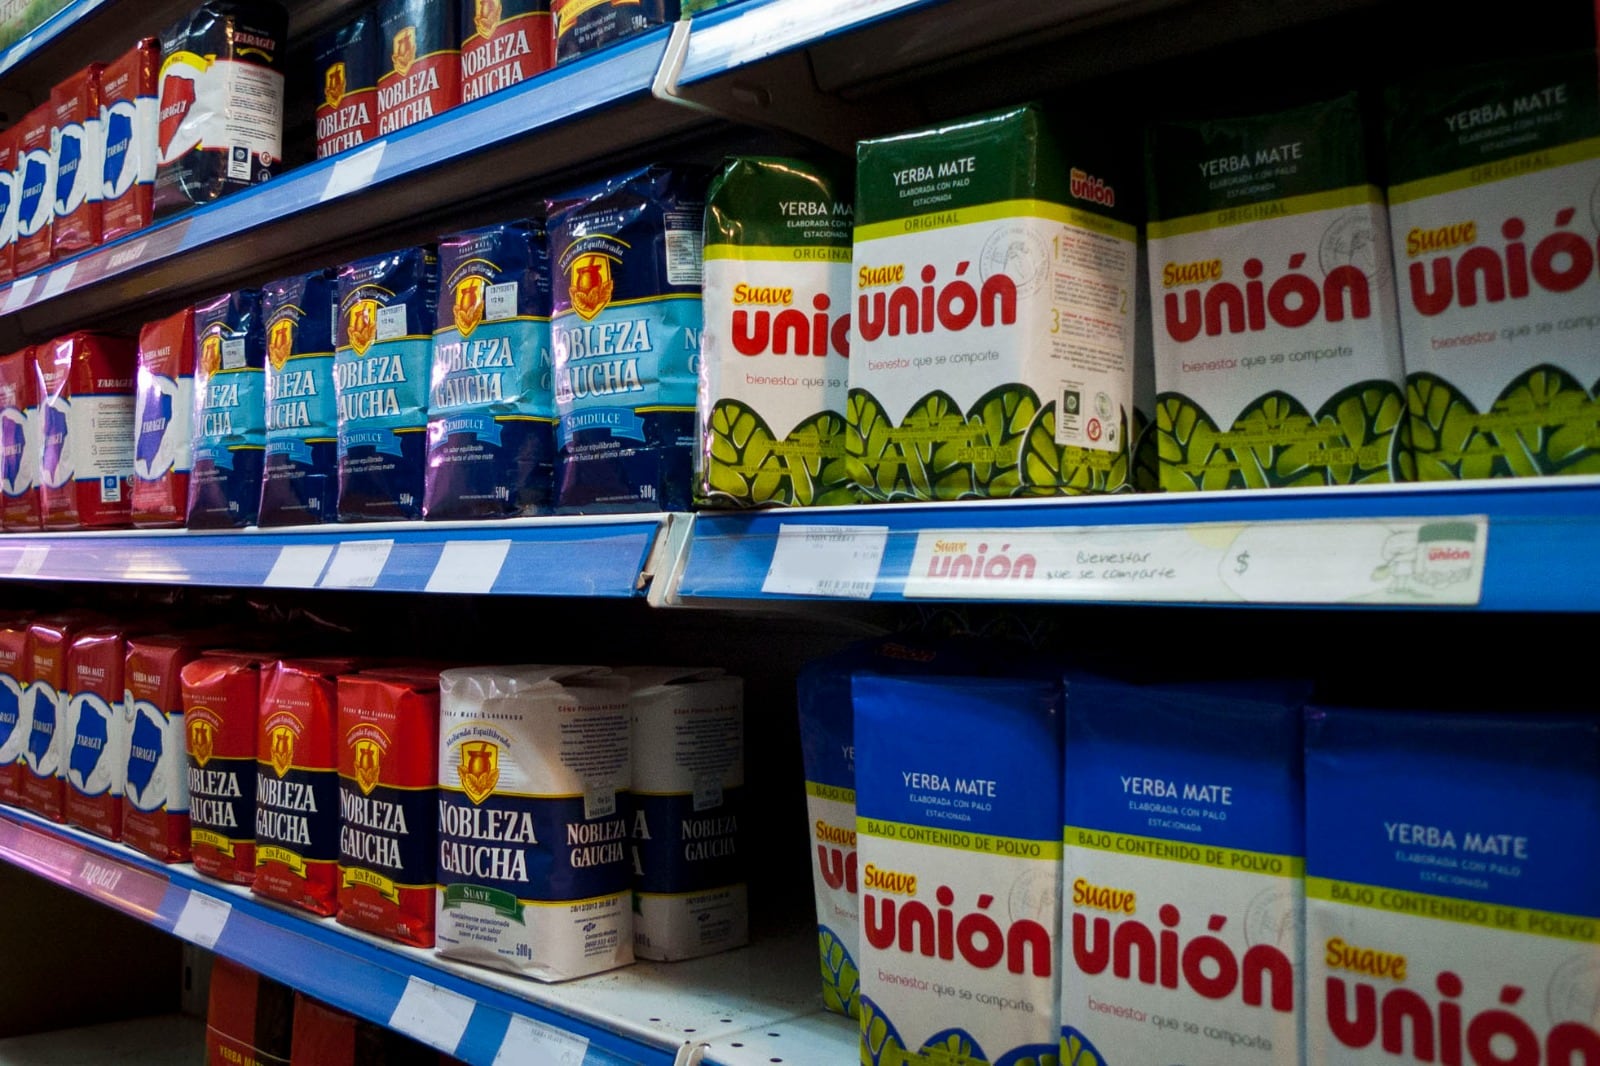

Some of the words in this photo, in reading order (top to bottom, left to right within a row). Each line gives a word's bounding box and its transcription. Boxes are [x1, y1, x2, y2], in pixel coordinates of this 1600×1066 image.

[461, 29, 531, 81] NOBLEZA
[377, 67, 440, 115] NOBLEZA
[463, 61, 524, 104] GAUCHA
[379, 96, 434, 137] GAUCHA
[1445, 103, 1508, 132] YERBA
[1513, 84, 1568, 115] MATE
[893, 165, 934, 186] YERBA
[938, 157, 976, 178] MATE
[1199, 155, 1250, 178] YERBA
[1255, 143, 1303, 166] MATE
[900, 183, 935, 198] ELABORADA
[937, 182, 950, 192] CON
[952, 178, 970, 188] PALO
[779, 202, 828, 216] YERBA
[904, 213, 960, 232] ORIGINAL
[1217, 202, 1288, 223] ORIGINAL
[787, 220, 829, 229] ELABORADA
[1406, 221, 1473, 257] Suave
[859, 264, 904, 288] Suave
[1164, 260, 1221, 286] Suave
[1410, 208, 1600, 317] unió
[734, 284, 792, 305] Suave
[858, 261, 1017, 342] unión
[1164, 253, 1371, 342] unión
[1051, 308, 1060, 333] 3
[1502, 325, 1531, 341] que
[869, 359, 910, 371] bienestar
[913, 355, 932, 367] que
[935, 354, 946, 366] se
[949, 350, 999, 366] comparte
[1182, 360, 1237, 372] bienestar
[1241, 355, 1266, 368] que
[1269, 354, 1285, 364] se
[1289, 346, 1353, 363] comparte
[435, 373, 503, 409] GAUCHA
[746, 373, 799, 386] bienestar
[802, 378, 824, 389] que
[827, 378, 840, 388] se
[338, 388, 400, 422] AUCHA
[444, 419, 485, 431] SEMIDULCE
[567, 412, 622, 430] SEMIDULCE
[934, 539, 967, 553] Suave
[1076, 551, 1152, 564] Bienestar
[927, 543, 1037, 580] unión
[1080, 570, 1094, 579] se
[1102, 567, 1176, 582] comparte
[1234, 550, 1249, 576] $
[257, 773, 318, 813] NOBLEZA
[902, 771, 951, 792] YERBA
[955, 778, 997, 798] MATE
[1120, 776, 1178, 799] YERBA
[1183, 783, 1233, 806] MATE
[340, 787, 409, 835] NOBLEZA
[909, 794, 951, 806] ELABORADA
[953, 799, 969, 809] CON
[971, 802, 992, 812] PALO
[926, 808, 971, 822] ESTACIONADA
[1129, 801, 1178, 815] ELABORADA
[1181, 807, 1200, 817] CON
[1202, 809, 1226, 821] PALO
[256, 808, 312, 845] GAUCHA
[438, 799, 538, 844] NOBLEZA
[567, 819, 627, 846] NOBLEZA
[682, 815, 738, 840] NOBLEZA
[816, 821, 856, 847] Suave
[1148, 818, 1202, 832] ESTACIONADA
[340, 825, 404, 870] GAUCHA
[685, 837, 736, 861] GAUCHA
[867, 821, 896, 837] BAJO
[899, 826, 970, 848] CONTENIDO
[975, 833, 991, 850] DE
[996, 839, 1041, 857] POLVO
[1384, 822, 1457, 849] YERBA
[1463, 832, 1528, 860] MATE
[265, 848, 274, 858] SIN
[275, 848, 291, 863] PALO
[441, 839, 530, 882] GAUCHA
[570, 842, 625, 868] GAUCHA
[1078, 832, 1111, 849] BAJO
[1116, 836, 1200, 862] CONTENIDO
[1206, 849, 1225, 865] DE
[1231, 852, 1283, 874] POLVO
[1395, 850, 1458, 869] ELABORADA
[1461, 860, 1487, 872] CON
[1490, 863, 1521, 878] PALO
[353, 869, 364, 880] SIN
[365, 870, 382, 887] PALO
[864, 865, 916, 893] Suave
[463, 886, 492, 902] SUAVE
[1073, 879, 1134, 913] Suave
[1331, 883, 1375, 905] BAJO
[1380, 891, 1488, 923] CONTENIDO
[1495, 909, 1515, 926] DE
[1528, 911, 1595, 939] POLVO
[864, 885, 1052, 978] unión
[516, 943, 532, 960] 500g
[1073, 903, 1293, 1013] unión
[1326, 938, 1406, 979] Suave
[878, 968, 929, 992] bienestar
[932, 983, 955, 998] que
[959, 988, 972, 1000] se
[976, 992, 1034, 1013] comparte
[1088, 995, 1147, 1022] bienestar
[1152, 1013, 1179, 1031] que
[1183, 1021, 1200, 1035] se
[1203, 1026, 1273, 1051] comparte
